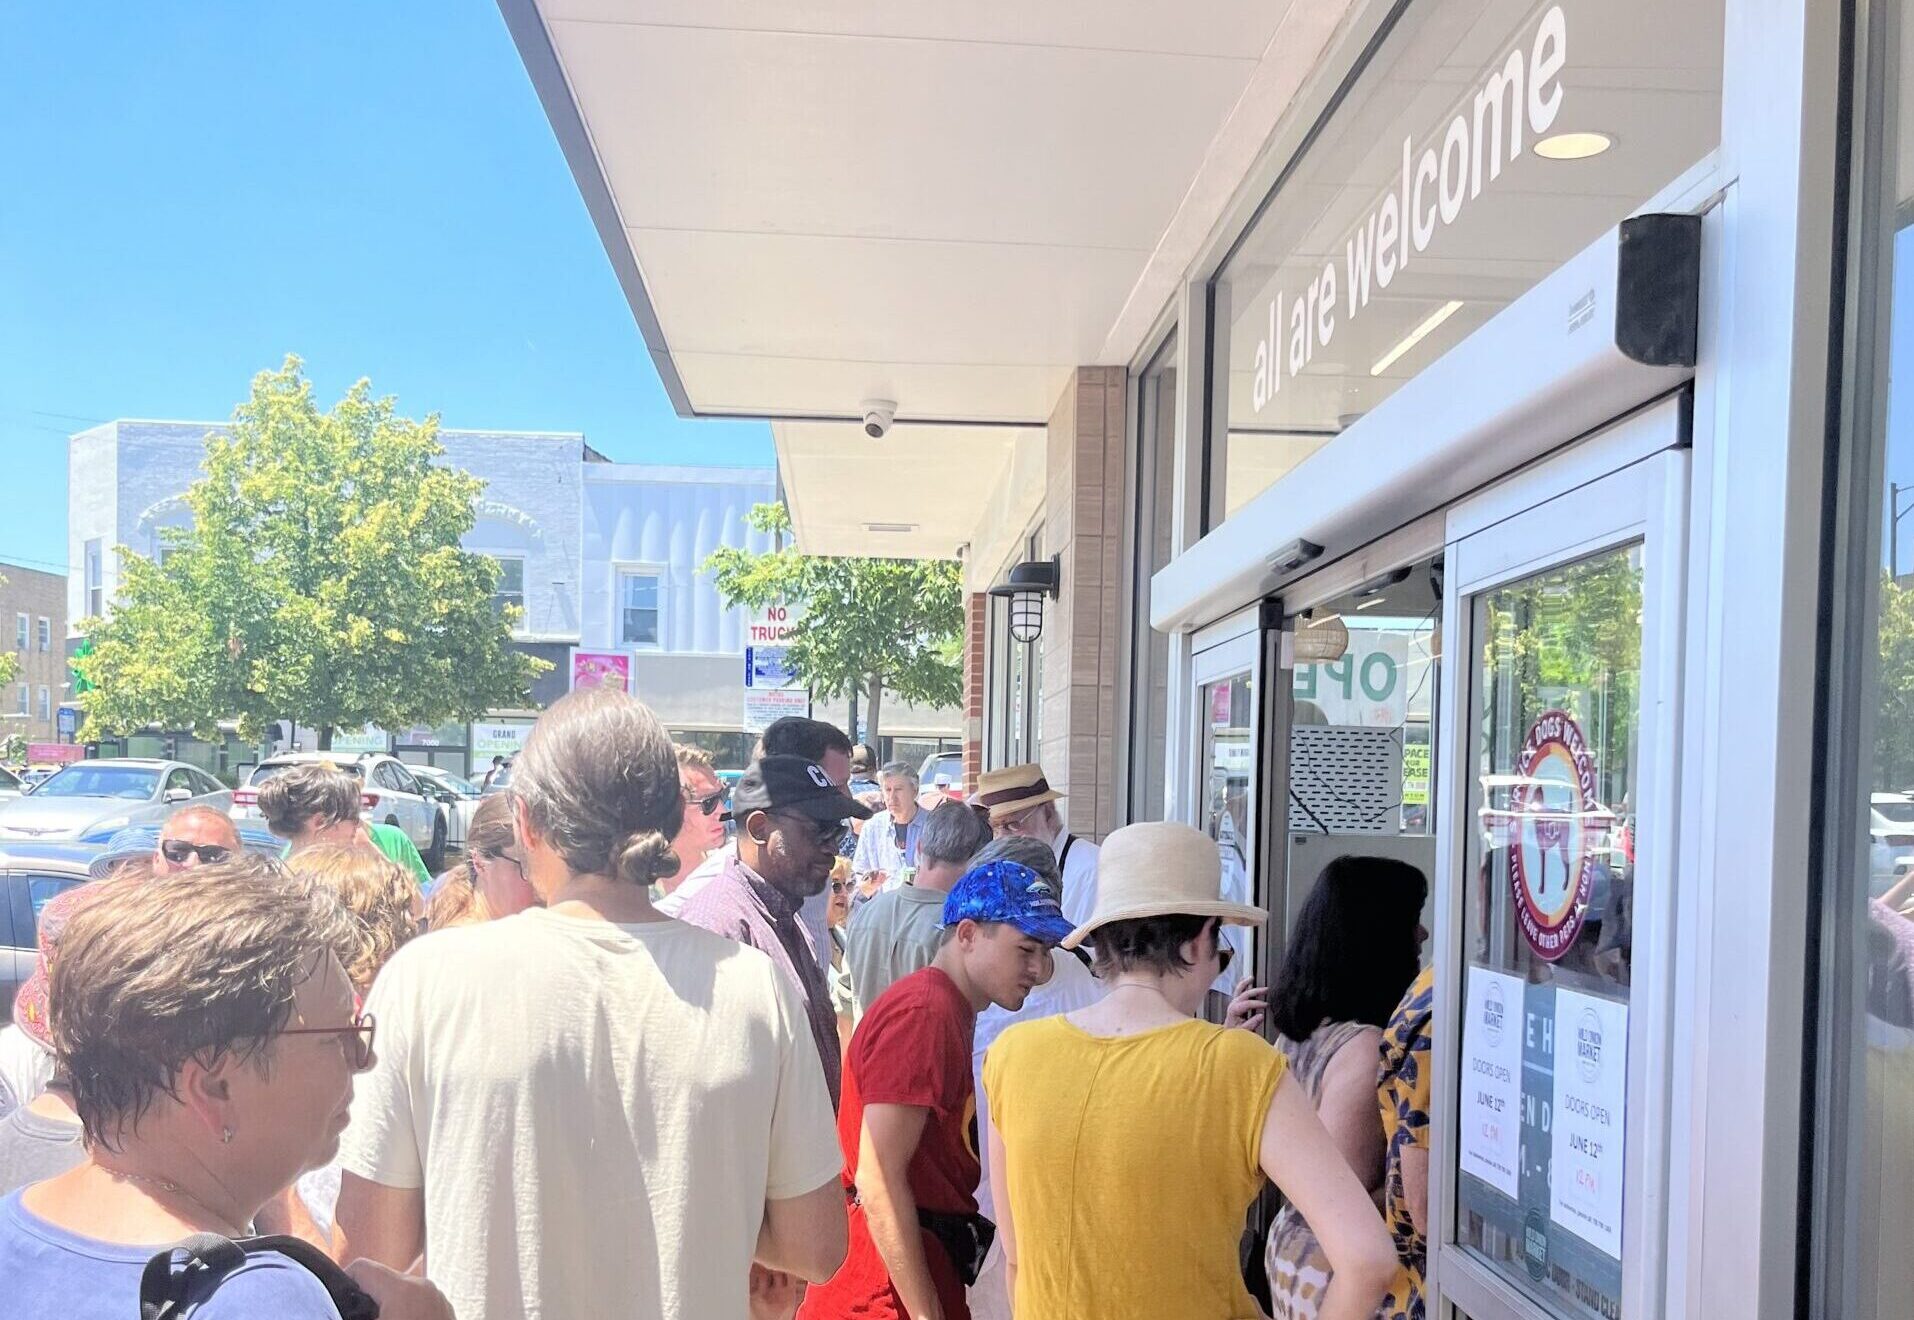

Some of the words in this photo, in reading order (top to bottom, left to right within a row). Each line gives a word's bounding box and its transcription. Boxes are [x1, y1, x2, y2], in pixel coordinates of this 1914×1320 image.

[1252, 290, 1284, 413] all
[1288, 261, 1337, 378] are
[1346, 5, 1567, 320] welcome
[768, 607, 786, 621] NO
[336, 735, 383, 745] PENING
[492, 729, 516, 739] GRAND
[1535, 716, 1560, 746] DOGS
[477, 739, 523, 749] OPENIN
[1404, 748, 1429, 759] PACE
[1403, 768, 1428, 778] EASE
[1577, 1041, 1601, 1063] MARKET
[1472, 1057, 1494, 1078] DOORS
[1495, 1065, 1511, 1083] OPEN
[1477, 1091, 1493, 1109] JUNE
[1564, 1094, 1589, 1117] DOORS
[1590, 1105, 1611, 1127] OPEN
[1569, 1132, 1588, 1154] JUNE
